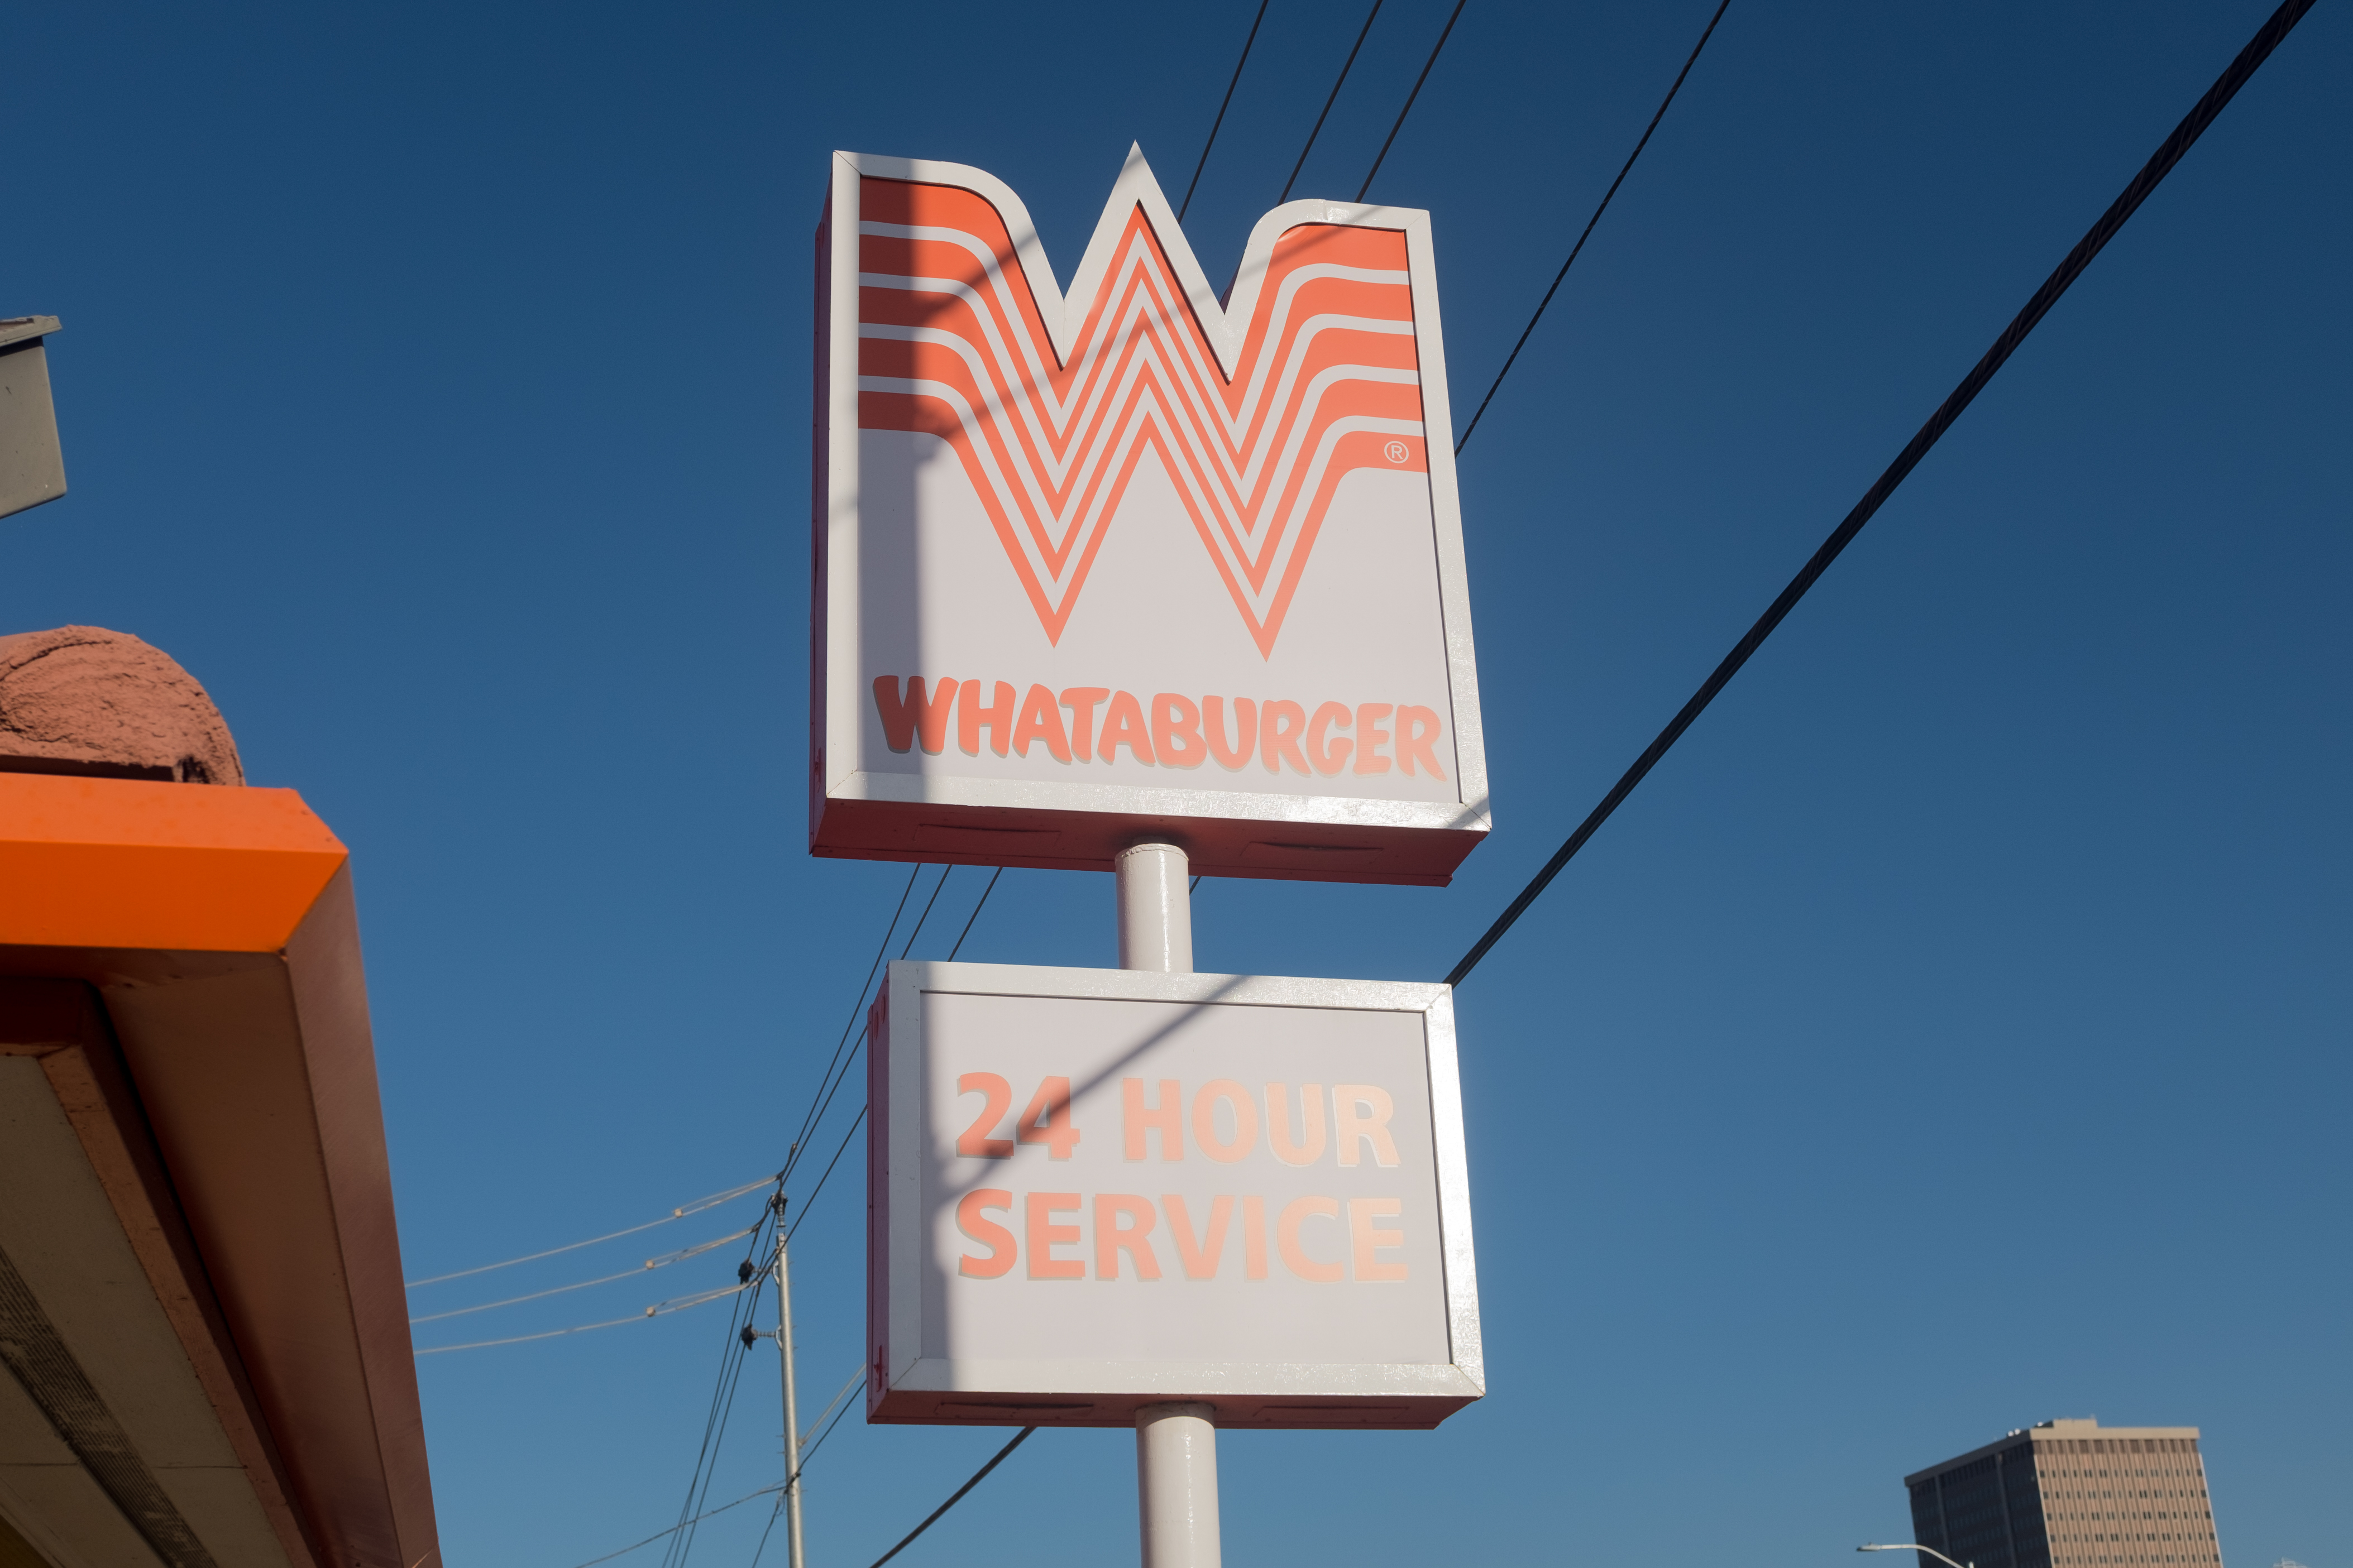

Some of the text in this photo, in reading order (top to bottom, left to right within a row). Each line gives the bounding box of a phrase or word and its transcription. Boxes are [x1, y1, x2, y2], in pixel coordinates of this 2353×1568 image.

[872, 675, 1447, 781] WHATABURGER
[956, 1072, 1402, 1167] 24 HOUR
[956, 1188, 1408, 1283] SERVICE
